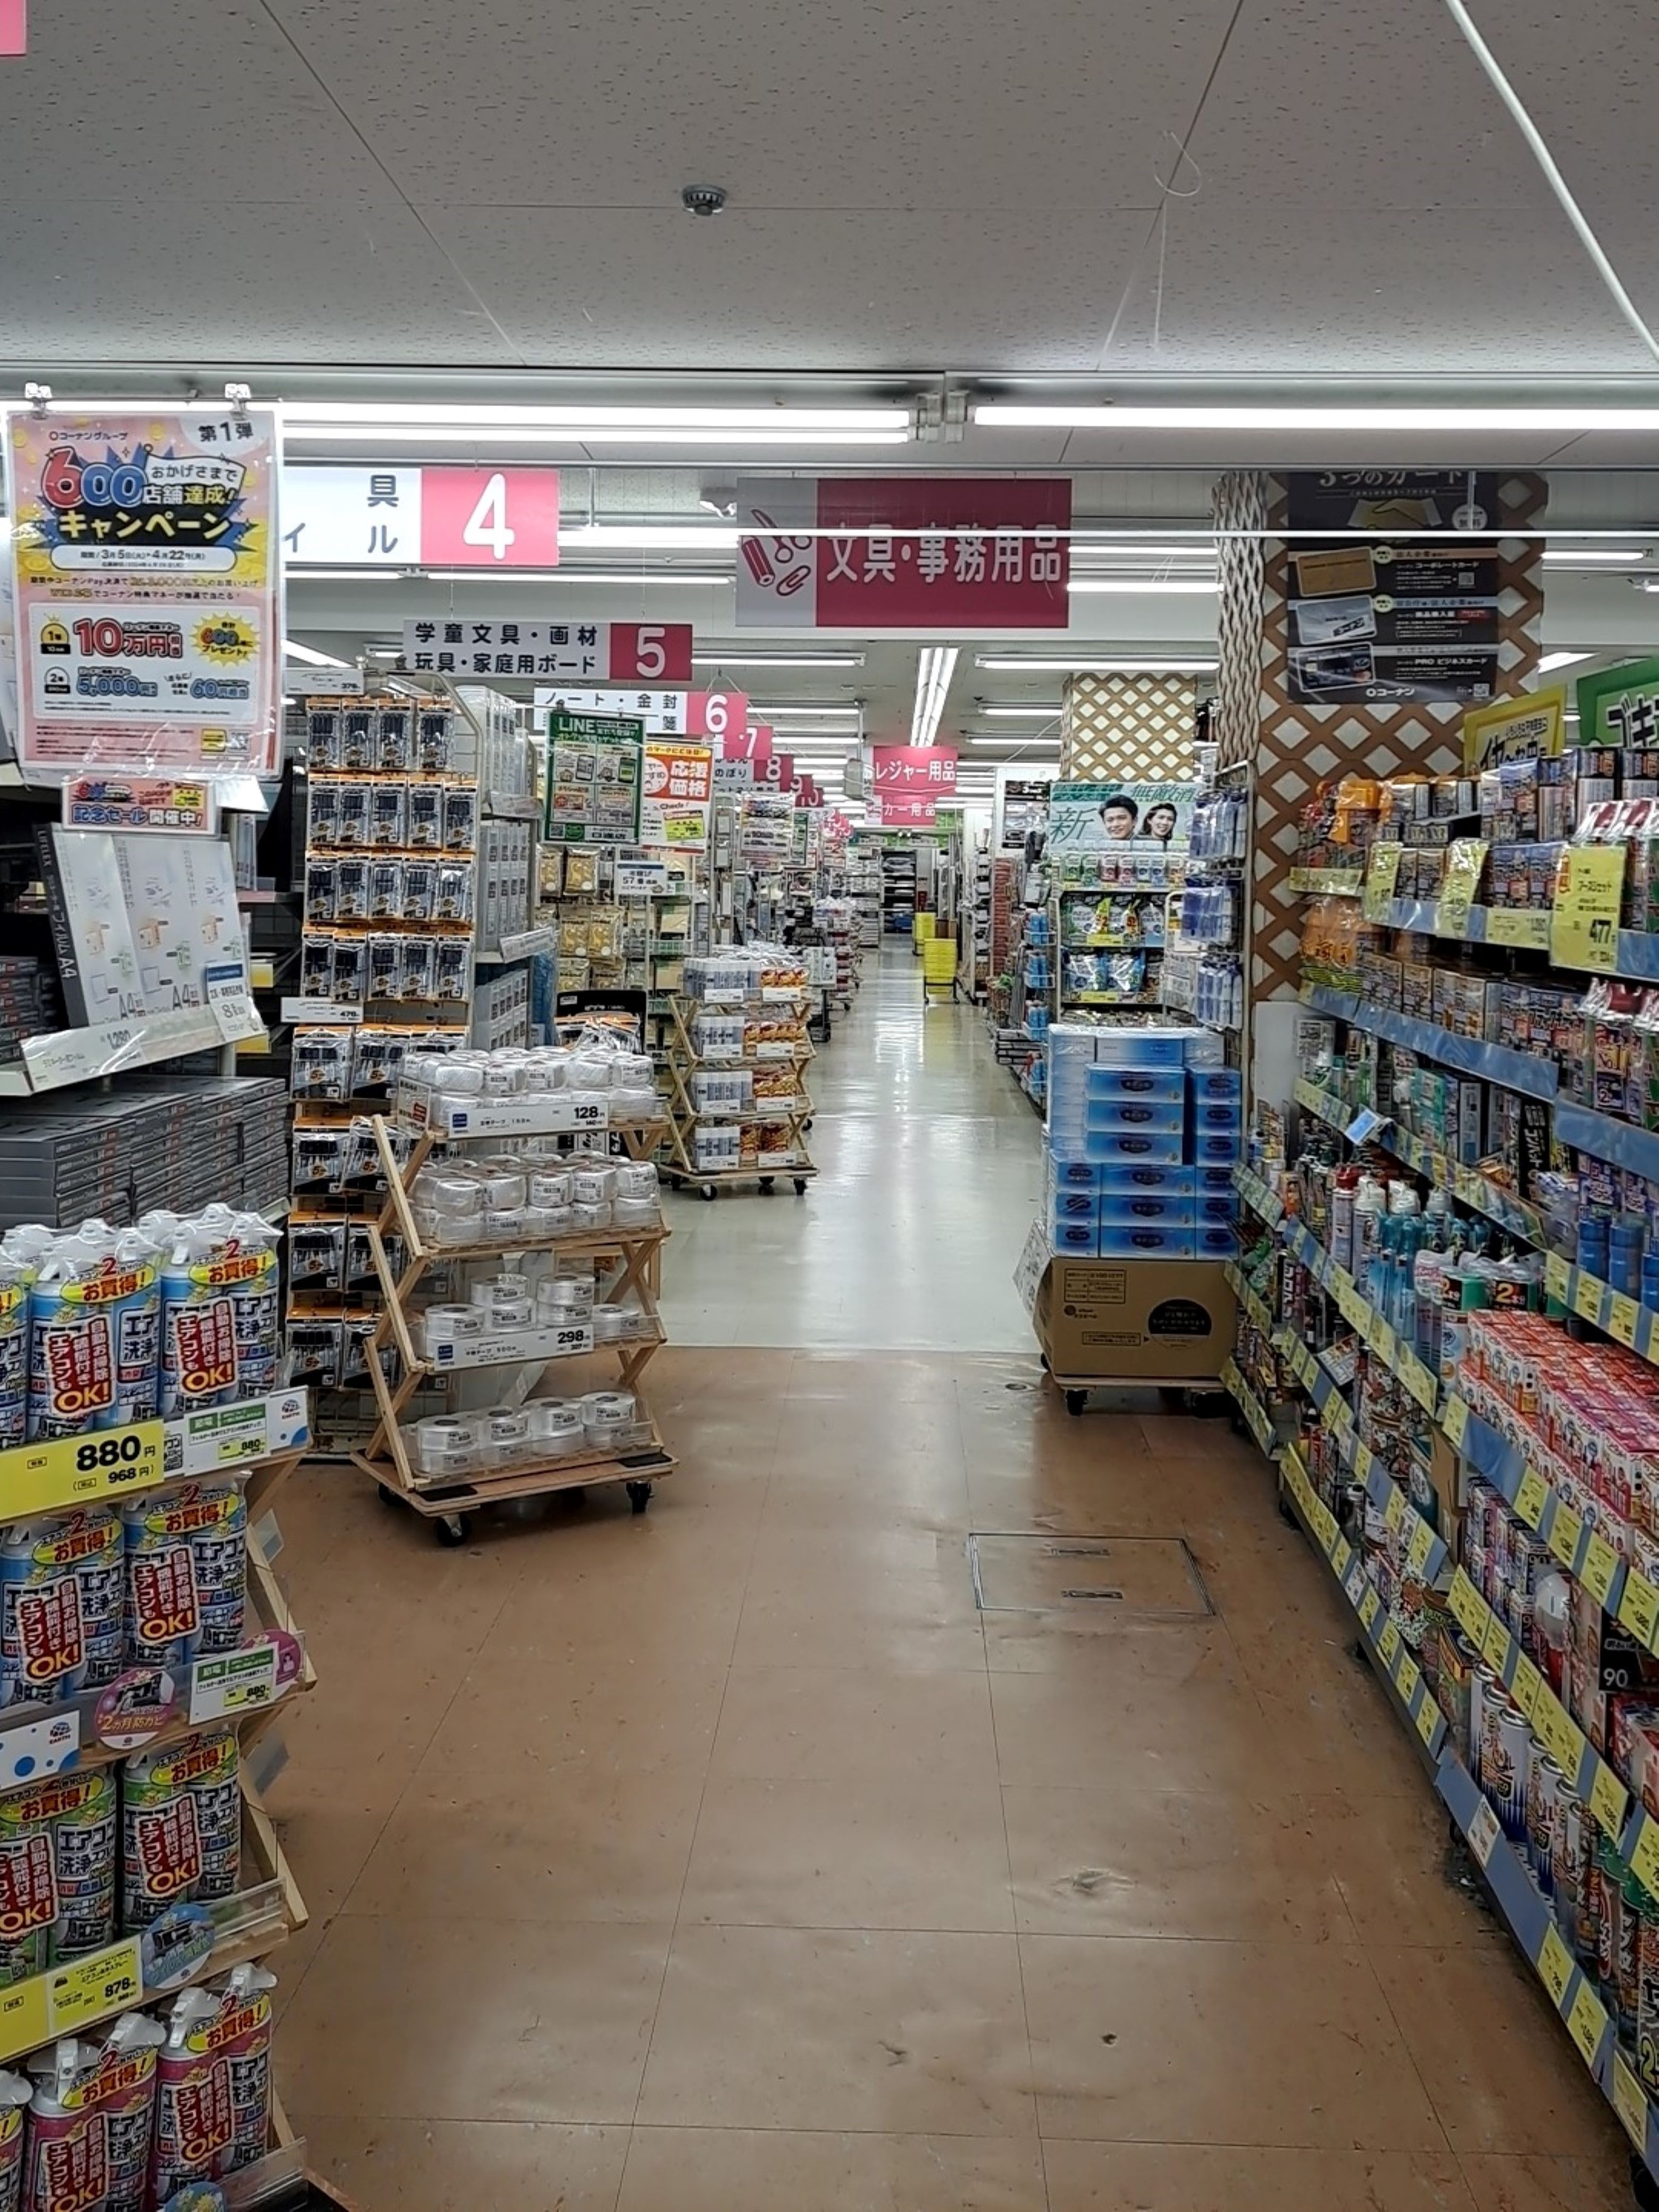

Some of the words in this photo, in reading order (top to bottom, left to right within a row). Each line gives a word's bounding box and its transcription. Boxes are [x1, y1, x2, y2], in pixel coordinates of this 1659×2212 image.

[199, 422, 254, 442] 第1弾
[42, 446, 147, 508] 600
[151, 465, 239, 483] おかげさまで
[367, 474, 399, 508] 具
[59, 510, 230, 540] キャンペーン
[463, 472, 515, 560] 4
[827, 522, 1061, 583] 文具・事務用品
[415, 622, 598, 646] 学童文具・画材
[415, 652, 596, 675] 玩具・家庭用ボード
[638, 627, 666, 678] 5
[559, 717, 596, 733] LINE
[705, 694, 728, 733] 6
[1606, 693, 1659, 748] ゴキ
[745, 726, 758, 758] 7
[766, 755, 782, 781] 8
[876, 760, 956, 782] レジャー用品
[58, 957, 78, 980] A4
[208, 1255, 266, 1283] お買得!
[83, 1270, 146, 1302] お買得!
[185, 1366, 233, 1391] OK!
[57, 1382, 110, 1412] OK!
[165, 1501, 229, 1532] お買得!
[54, 1527, 114, 1562] お買得!
[144, 1610, 194, 1638] OK!
[30, 1644, 79, 1676] OK!
[1603, 1668, 1629, 1688] 90
[171, 1744, 227, 1782] お買得!
[21, 1784, 91, 1821] お買得!
[151, 1858, 197, 1891] OK!
[0, 1900, 52, 1932] OK!
[105, 1977, 130, 1998] 878
[206, 2004, 262, 2048] お買得!
[82, 2057, 147, 2104] お買得!
[186, 2122, 230, 2159] OK!
[54, 2179, 103, 2212] OK!
